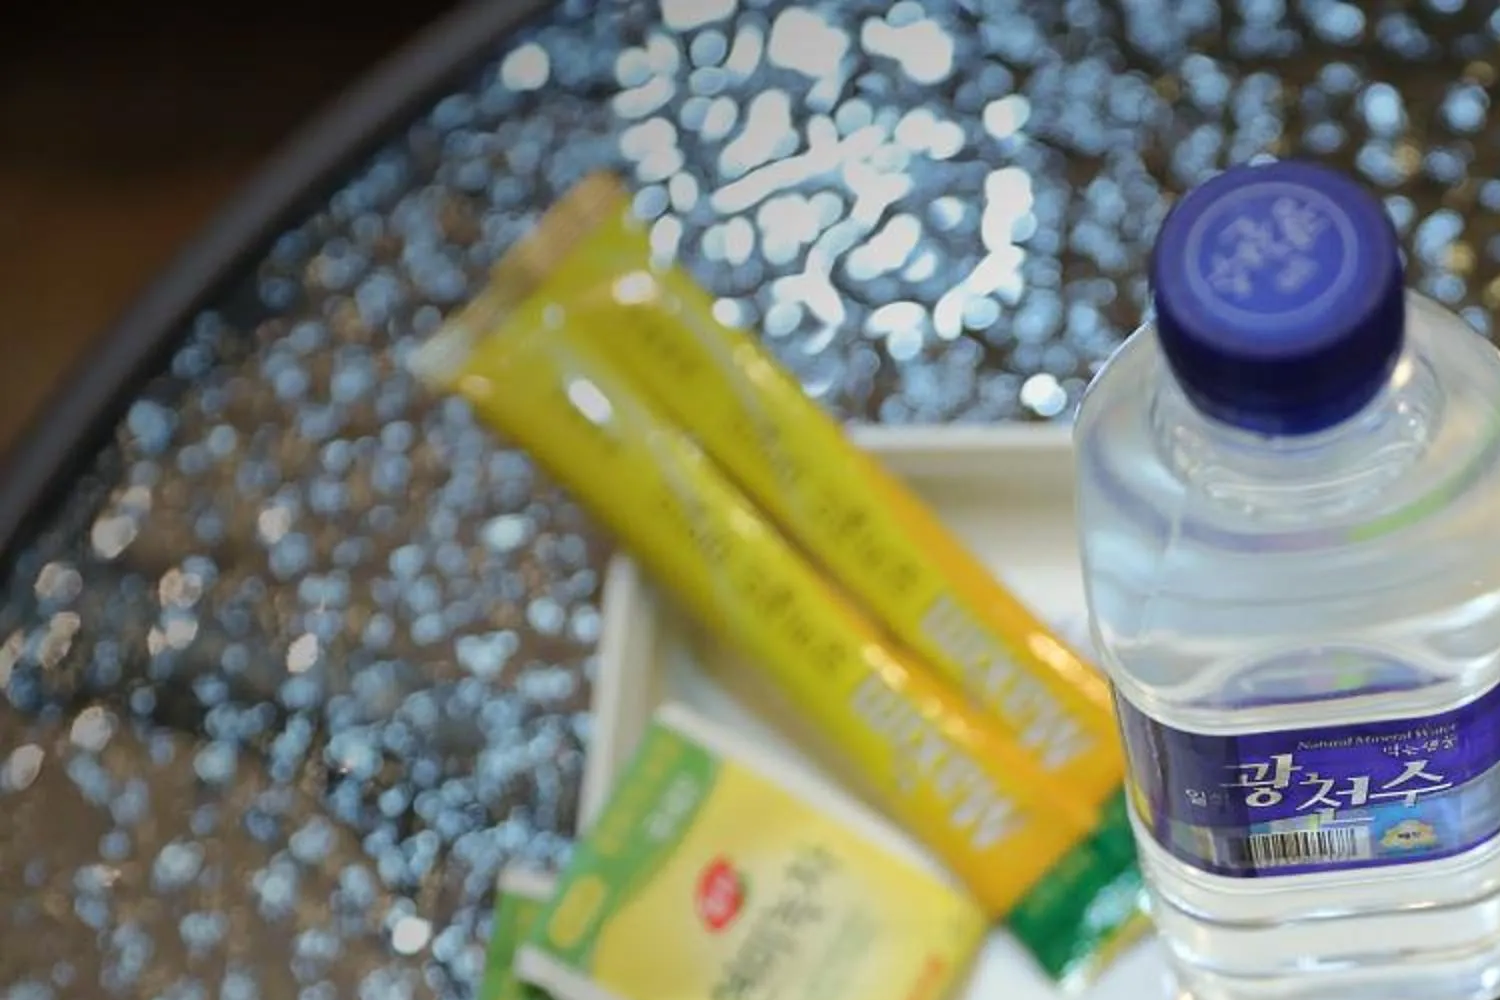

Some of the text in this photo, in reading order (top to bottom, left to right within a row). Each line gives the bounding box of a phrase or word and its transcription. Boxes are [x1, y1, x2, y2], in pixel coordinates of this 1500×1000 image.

[852, 671, 1033, 850] Maxim
[1297, 723, 1456, 750] Natural Mineral Water
[1221, 752, 1453, 823] 광천수
